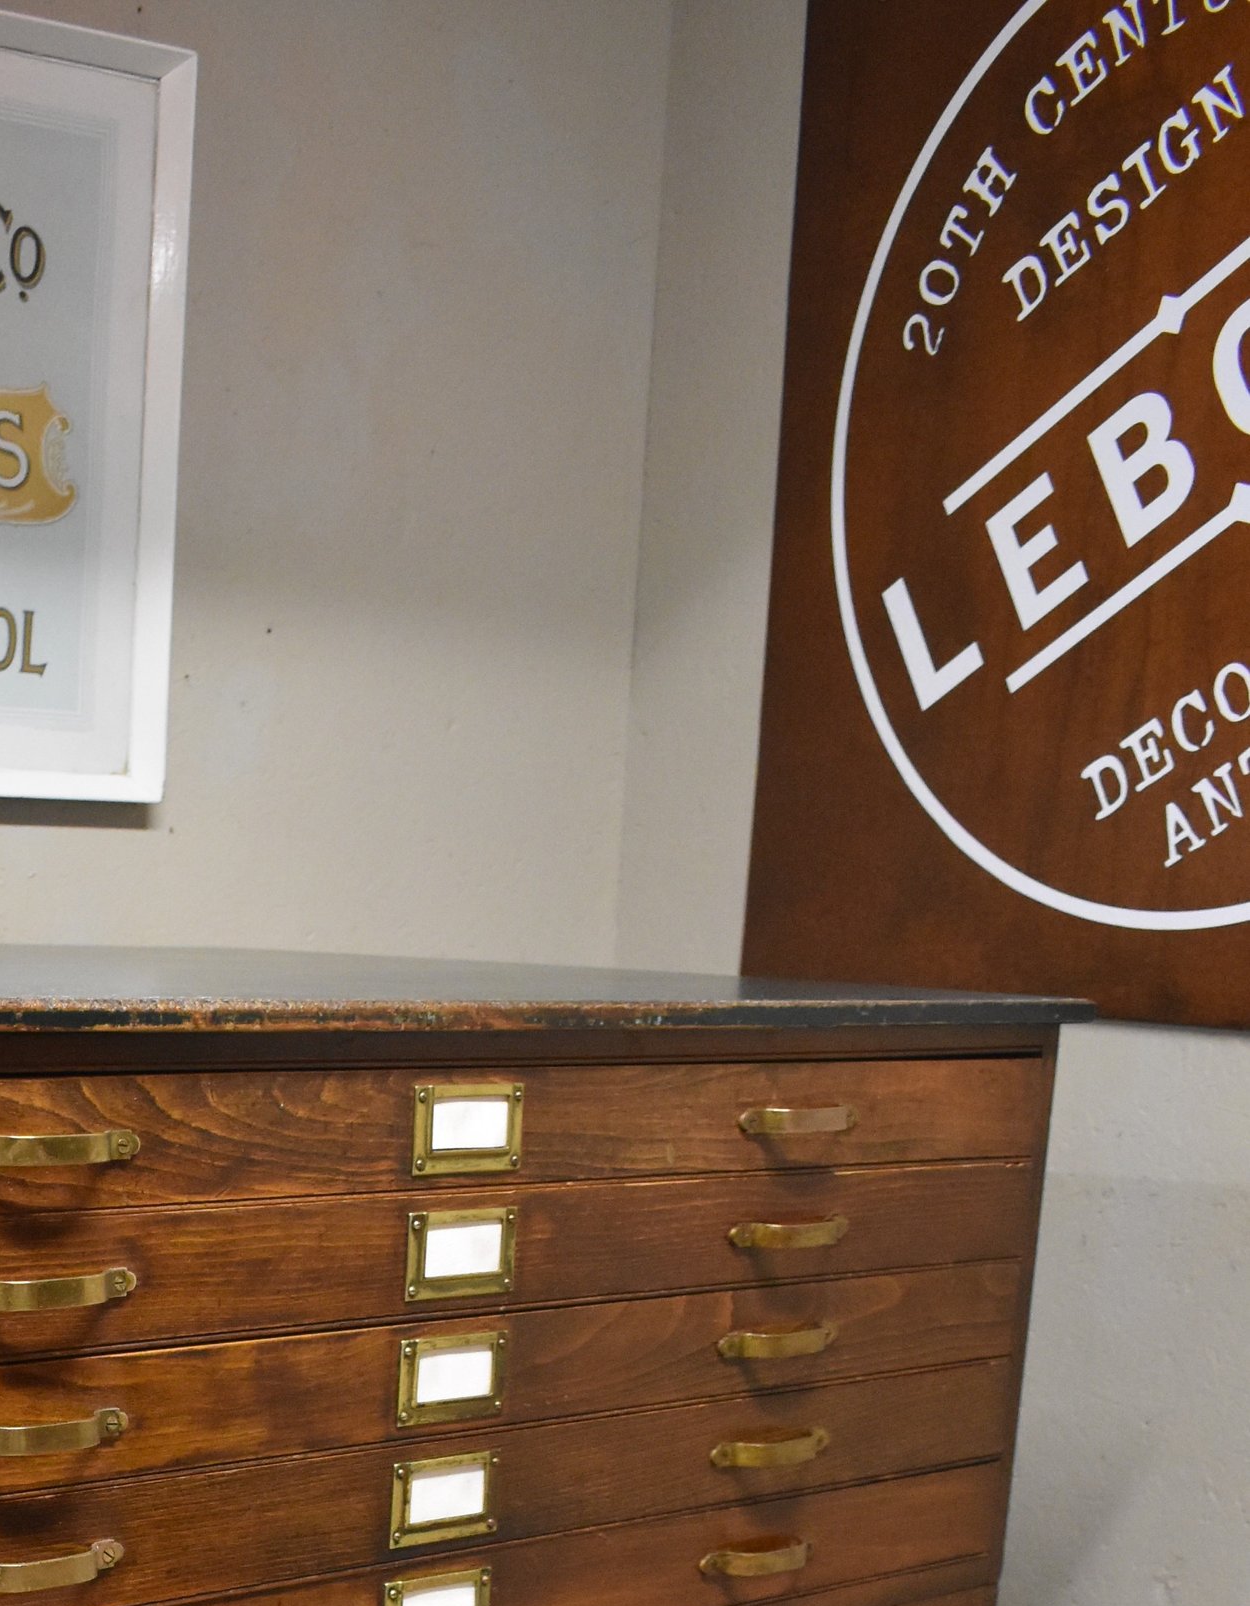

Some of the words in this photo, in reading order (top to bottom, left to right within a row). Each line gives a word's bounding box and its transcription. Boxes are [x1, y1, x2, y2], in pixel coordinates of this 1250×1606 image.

[902, 145, 1018, 356] 20TH
[1024, 0, 1230, 136] CENT
[1002, 66, 1245, 322] DESIGN
[1163, 746, 1250, 868] AN
